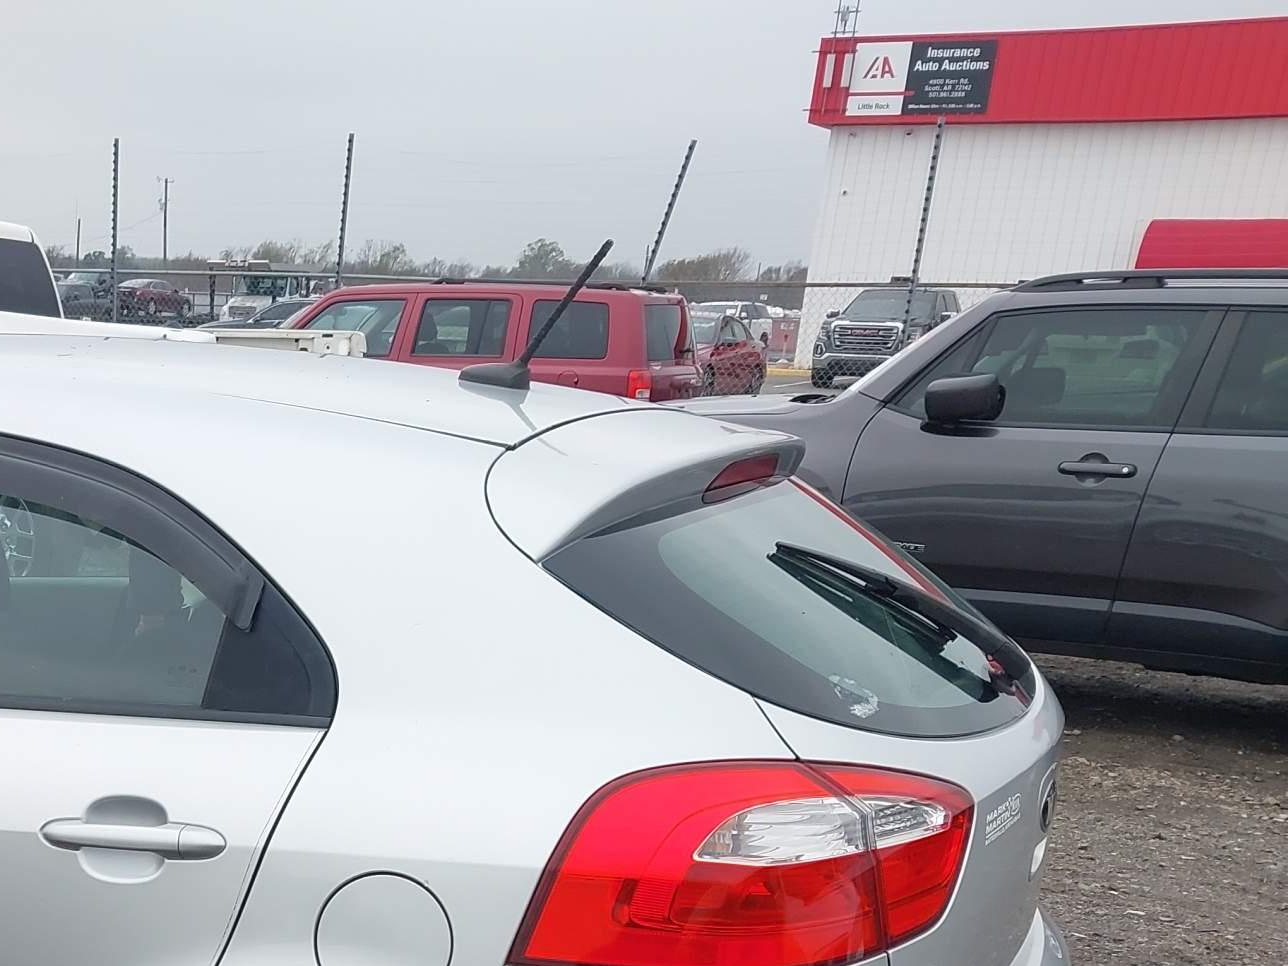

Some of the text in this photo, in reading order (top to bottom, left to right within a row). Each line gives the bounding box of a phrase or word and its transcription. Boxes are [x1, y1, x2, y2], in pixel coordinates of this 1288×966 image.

[927, 47, 981, 57] Insurance
[913, 59, 990, 71] Auto Auctions
[986, 801, 1010, 824] MARK
[985, 811, 1010, 834] MARTIN
